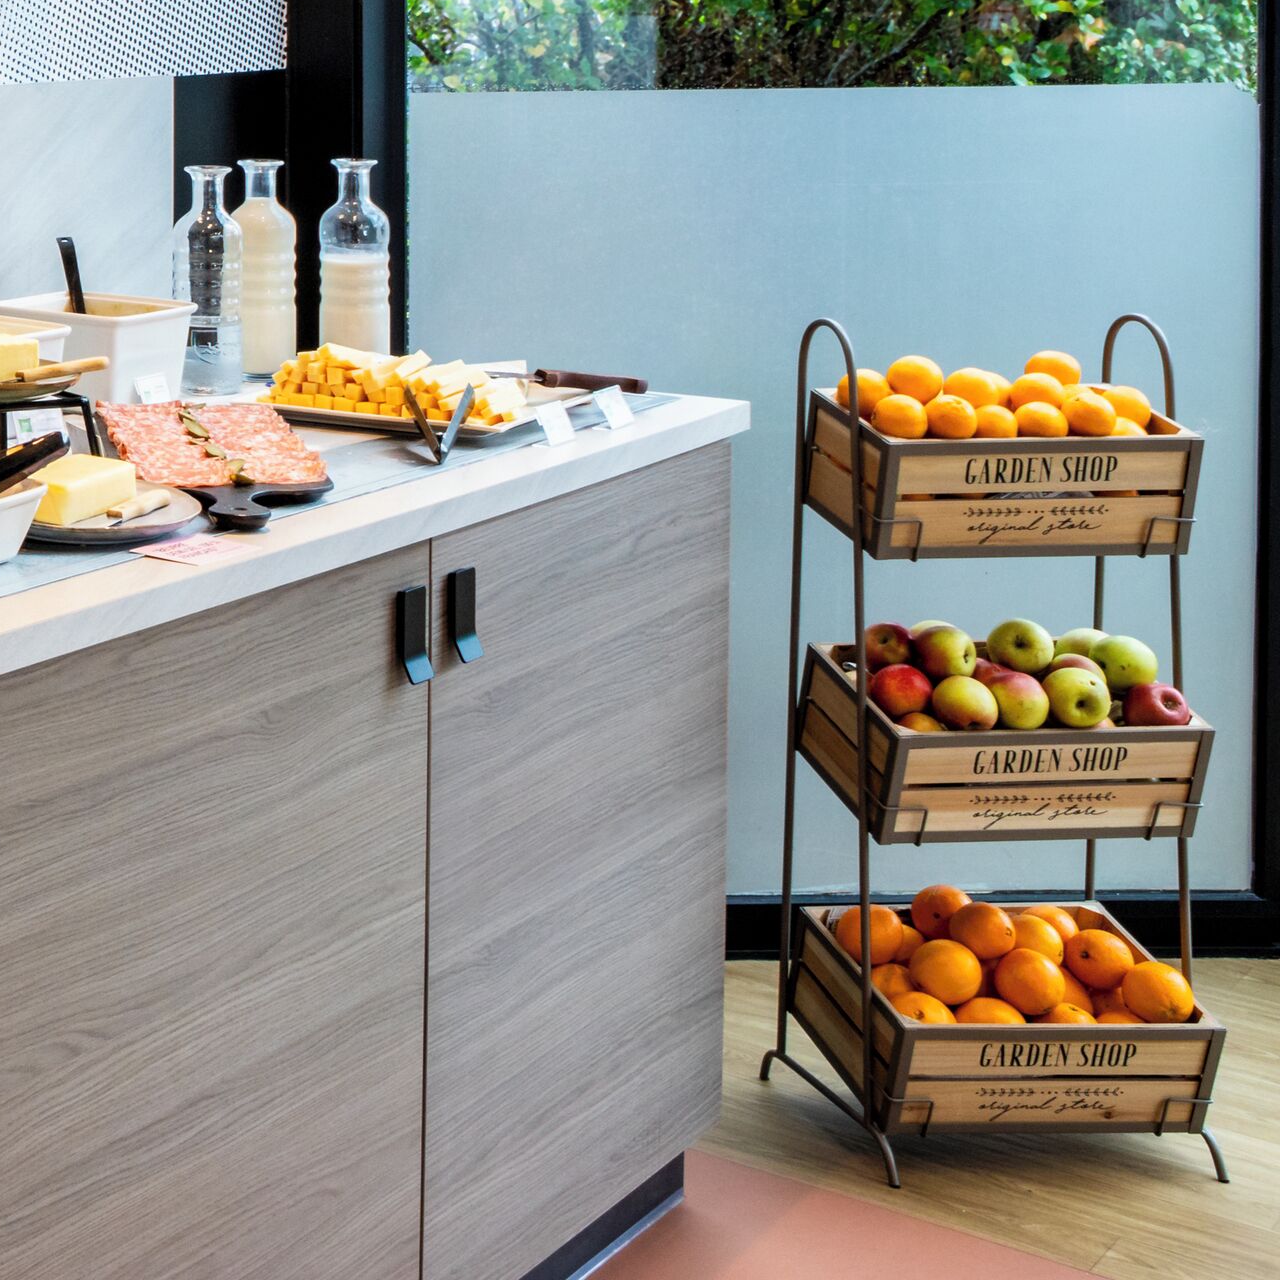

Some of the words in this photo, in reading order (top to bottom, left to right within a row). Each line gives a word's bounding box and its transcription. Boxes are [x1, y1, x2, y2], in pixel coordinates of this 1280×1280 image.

[964, 456, 1053, 484] GARDEN
[1060, 456, 1118, 483] SHOP
[967, 516, 1044, 545] original
[1042, 518, 1102, 535] store
[972, 748, 1063, 775] GARDEN
[1069, 746, 1128, 772] SHOP
[972, 803, 1050, 830] original
[1048, 804, 1108, 821] store
[979, 1043, 1071, 1068] GARDEN
[1076, 1043, 1137, 1067] SHOP
[978, 1096, 1057, 1122] original
[1054, 1098, 1116, 1114] store
